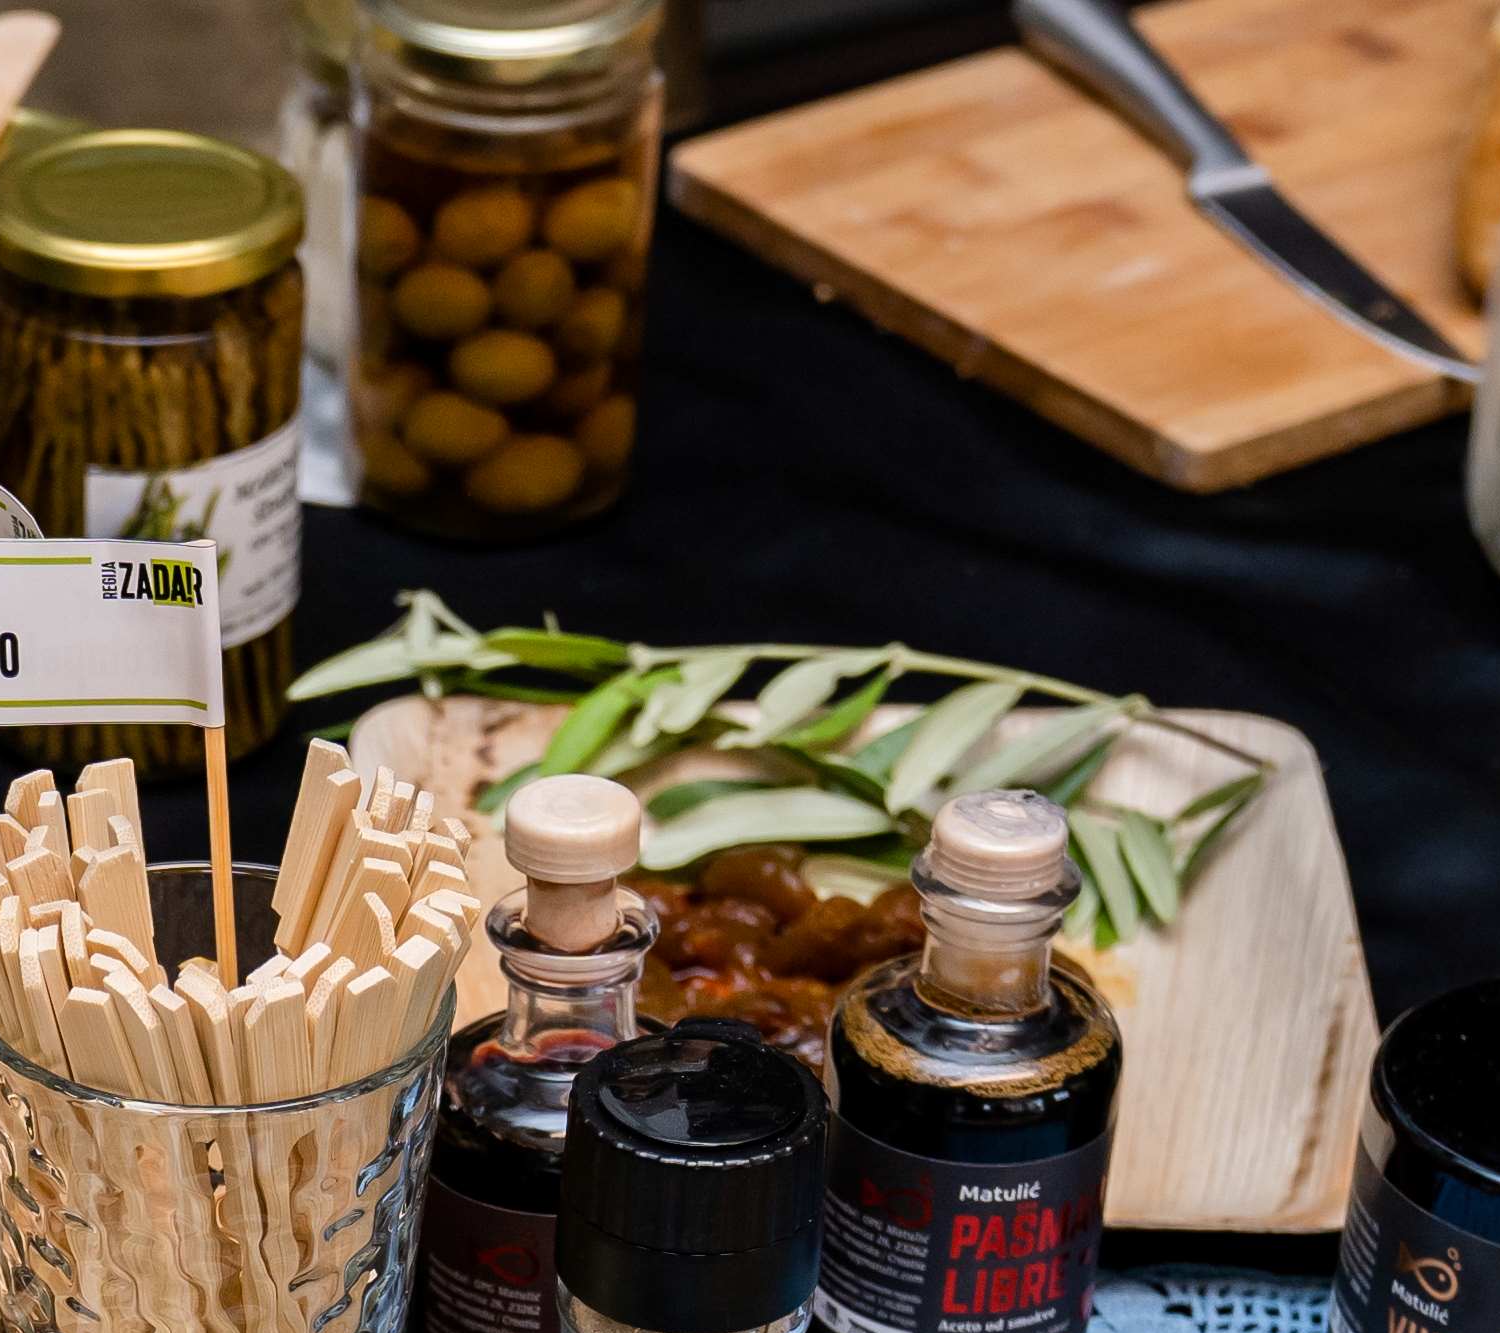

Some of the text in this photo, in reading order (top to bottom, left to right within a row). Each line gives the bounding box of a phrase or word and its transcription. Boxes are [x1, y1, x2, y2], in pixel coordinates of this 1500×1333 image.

[101, 561, 117, 600] REGIJA
[959, 1180, 1041, 1202] Matulić
[942, 1254, 1068, 1313] LIBRE
[1391, 1279, 1449, 1325] Matulić
